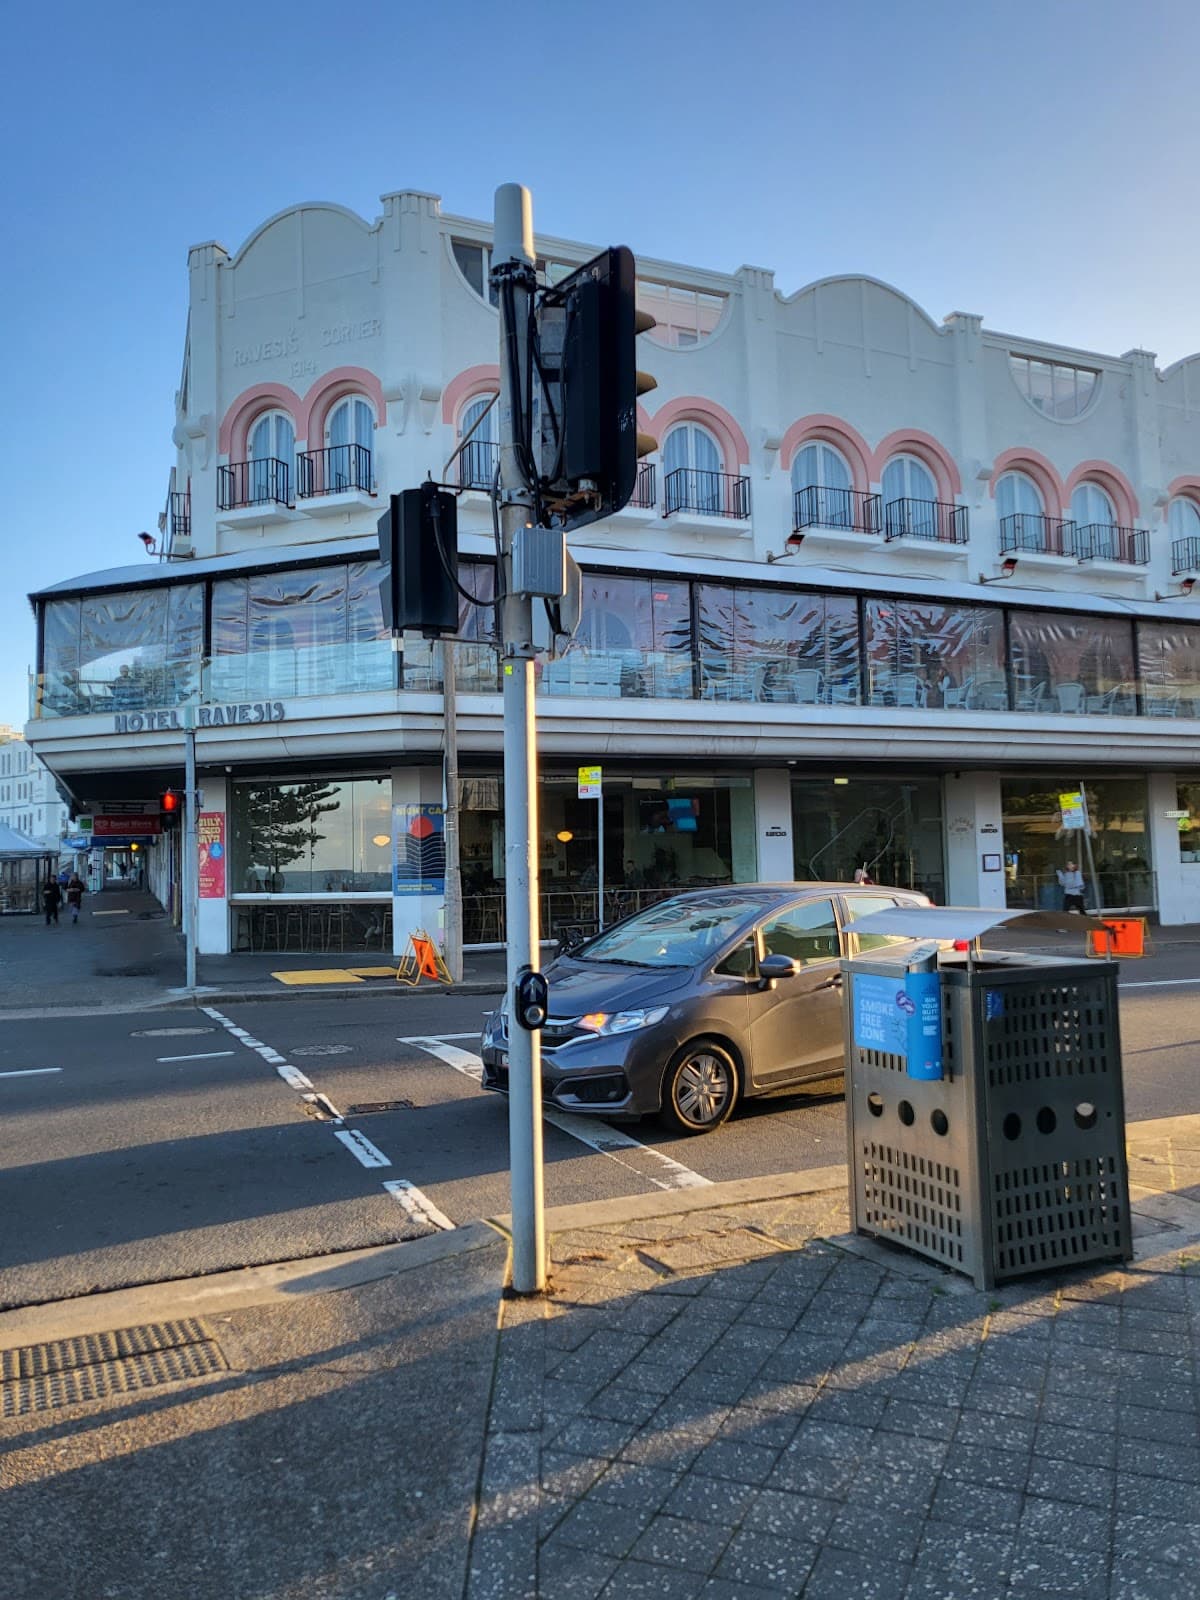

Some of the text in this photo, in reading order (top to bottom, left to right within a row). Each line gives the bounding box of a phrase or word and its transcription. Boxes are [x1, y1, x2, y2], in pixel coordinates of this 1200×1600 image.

[319, 318, 382, 347] CORNER
[114, 702, 286, 733] HOTEL RAVESIS
[428, 807, 444, 815] CA
[860, 999, 895, 1017] SMOKE
[860, 1012, 882, 1028] FREE
[860, 1025, 886, 1042] ZONE
